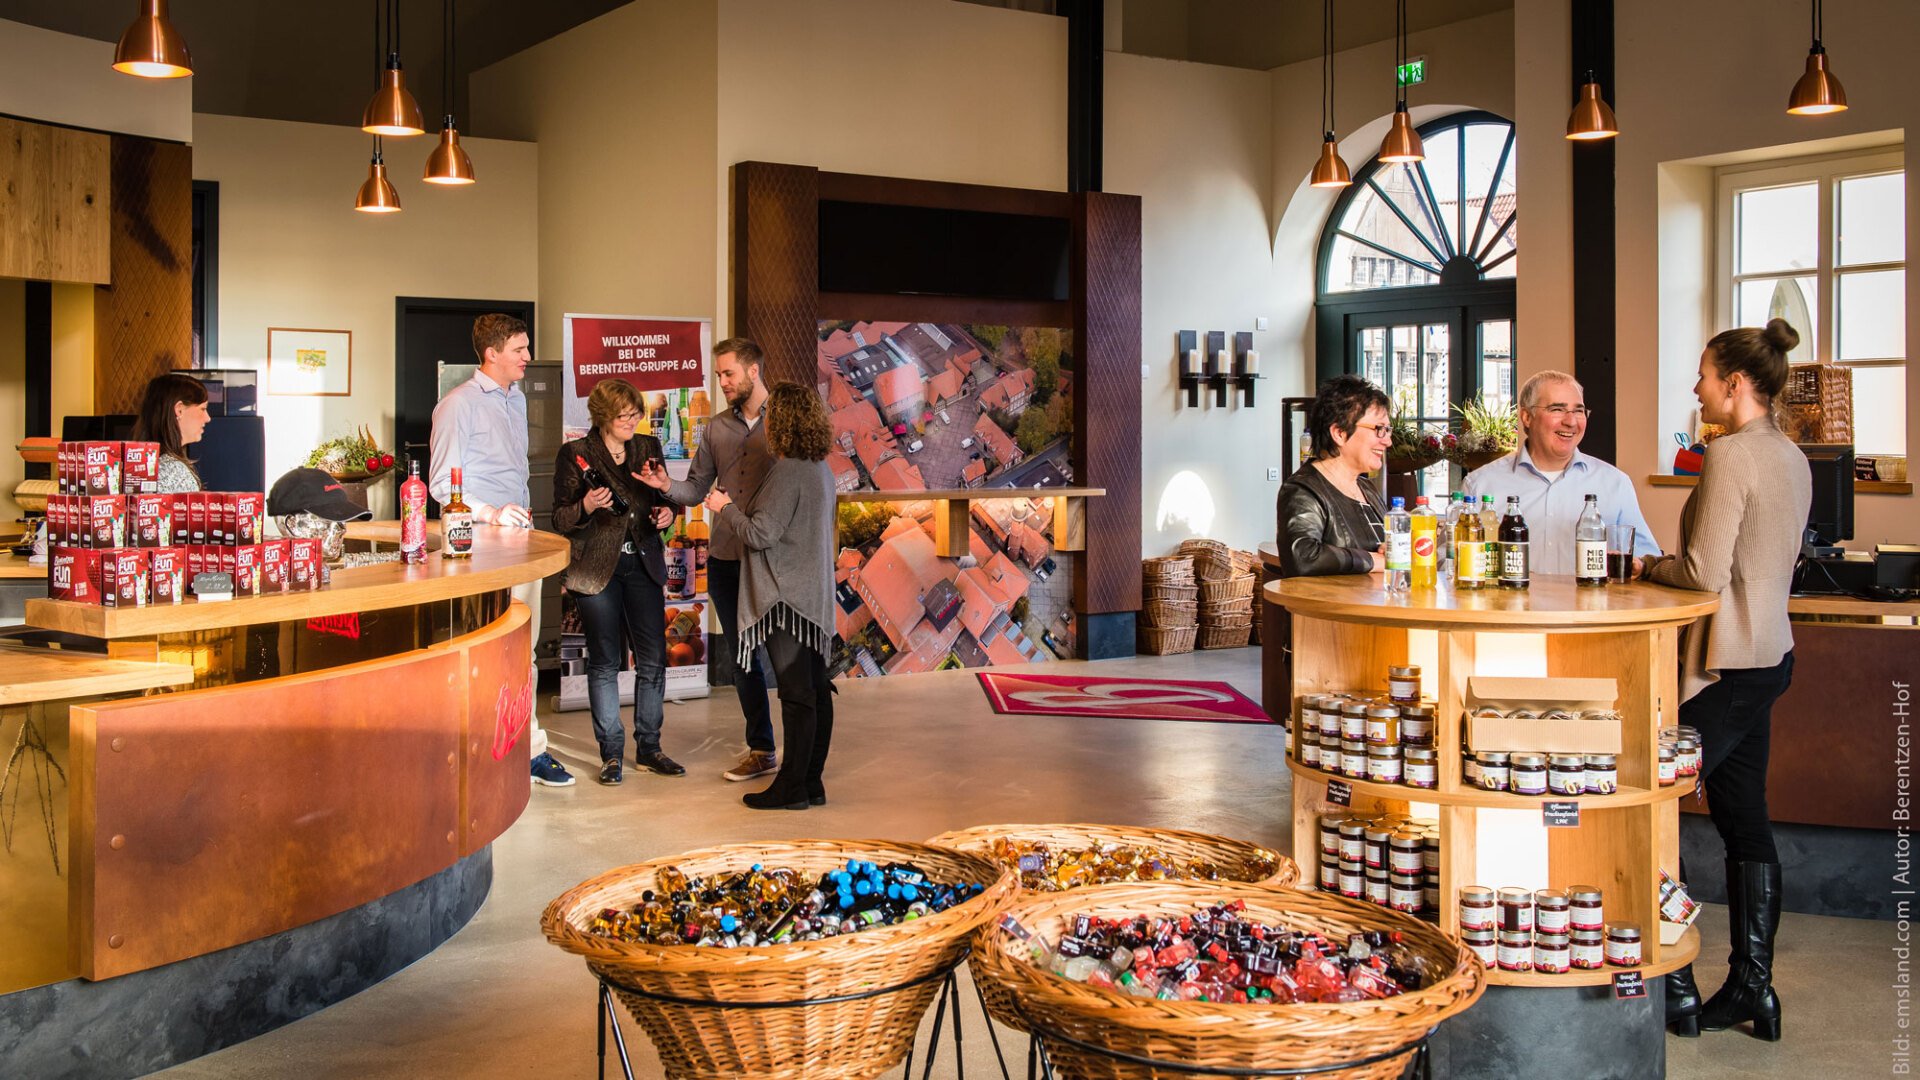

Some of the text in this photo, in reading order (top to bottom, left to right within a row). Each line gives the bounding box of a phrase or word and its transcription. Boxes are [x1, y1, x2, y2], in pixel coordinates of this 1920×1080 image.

[602, 334, 670, 347] WILLKOMMEN
[618, 348, 656, 360] BEI DER
[579, 359, 697, 375] BERENTZEN-GRUPPE AG
[1505, 551, 1523, 559] MIO
